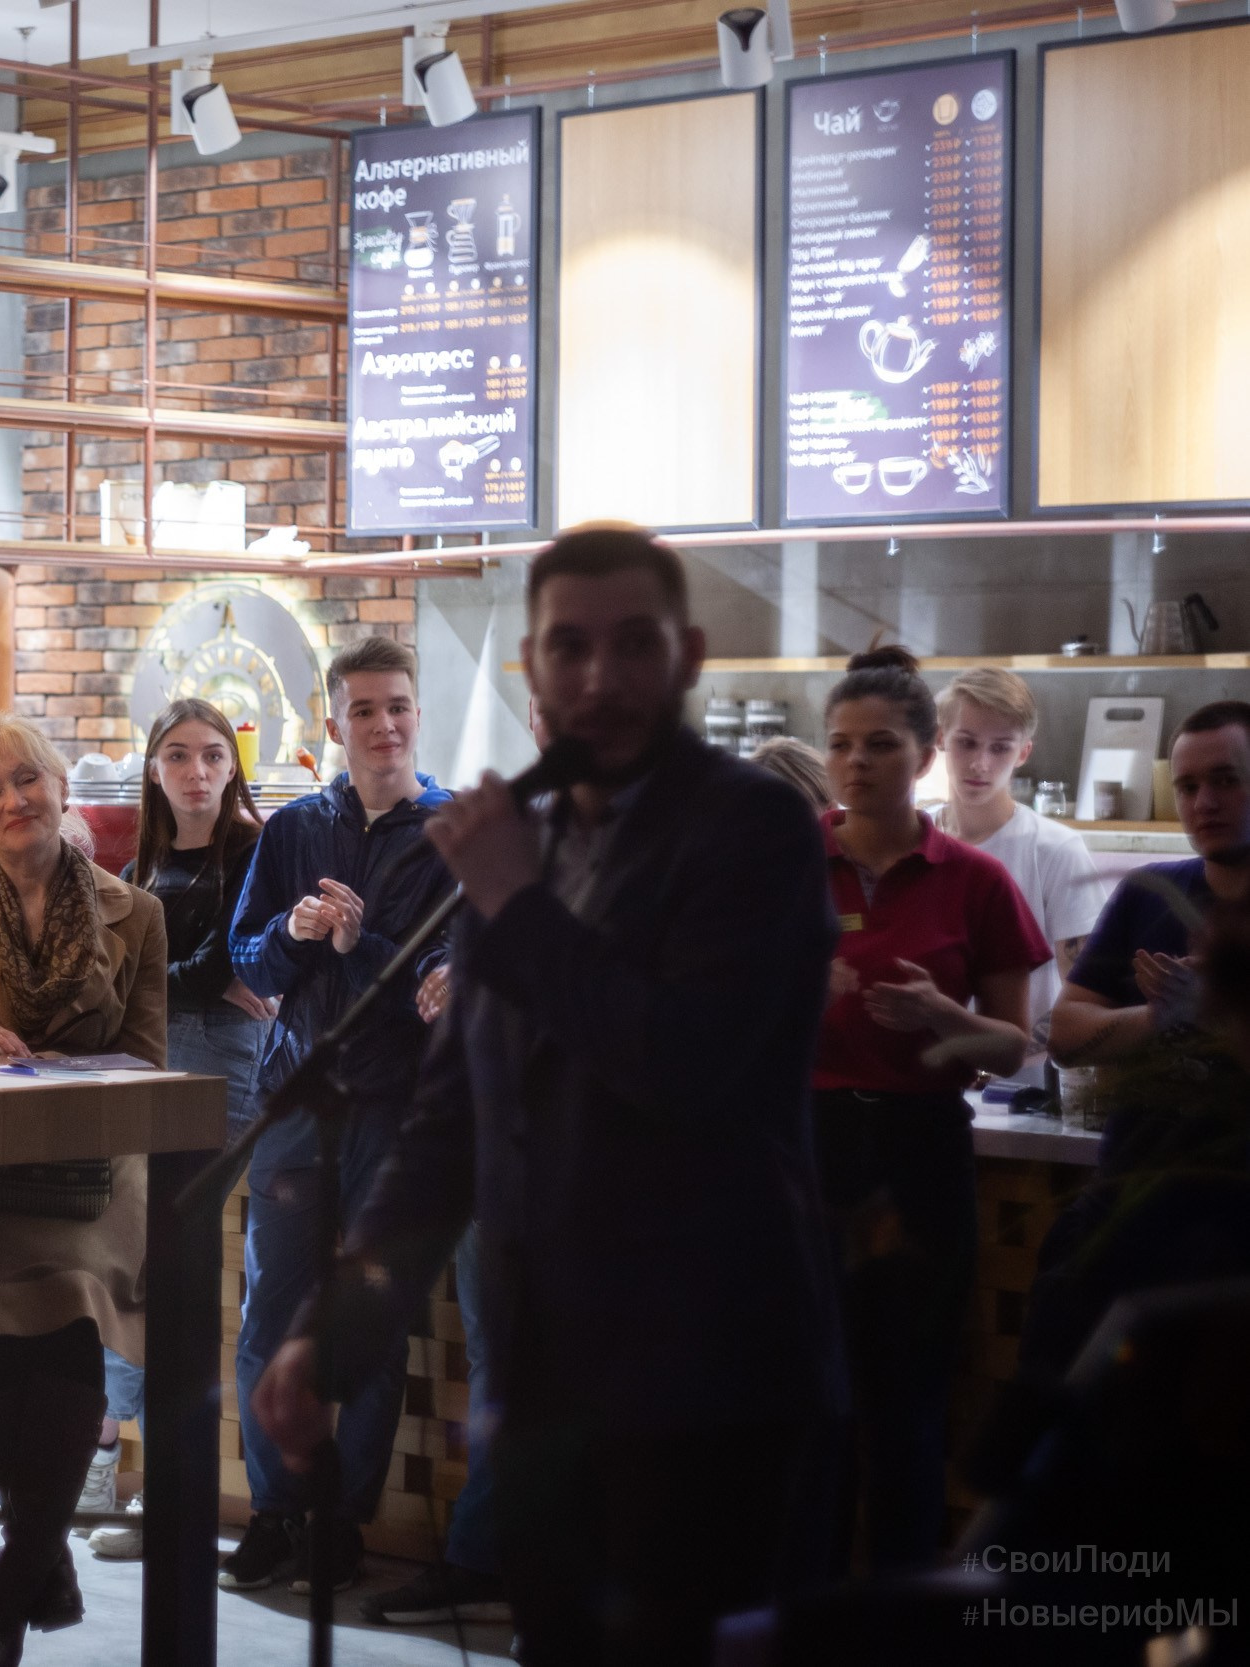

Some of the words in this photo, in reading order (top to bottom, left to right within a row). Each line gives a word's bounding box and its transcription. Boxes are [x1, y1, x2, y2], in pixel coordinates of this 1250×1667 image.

[814, 105, 862, 136] Чай
[354, 139, 529, 182] Альтернативный
[355, 185, 407, 213] кофе
[361, 349, 475, 379] Аэропресс
[353, 407, 516, 444] Австралийский
[353, 447, 415, 475] лунго
